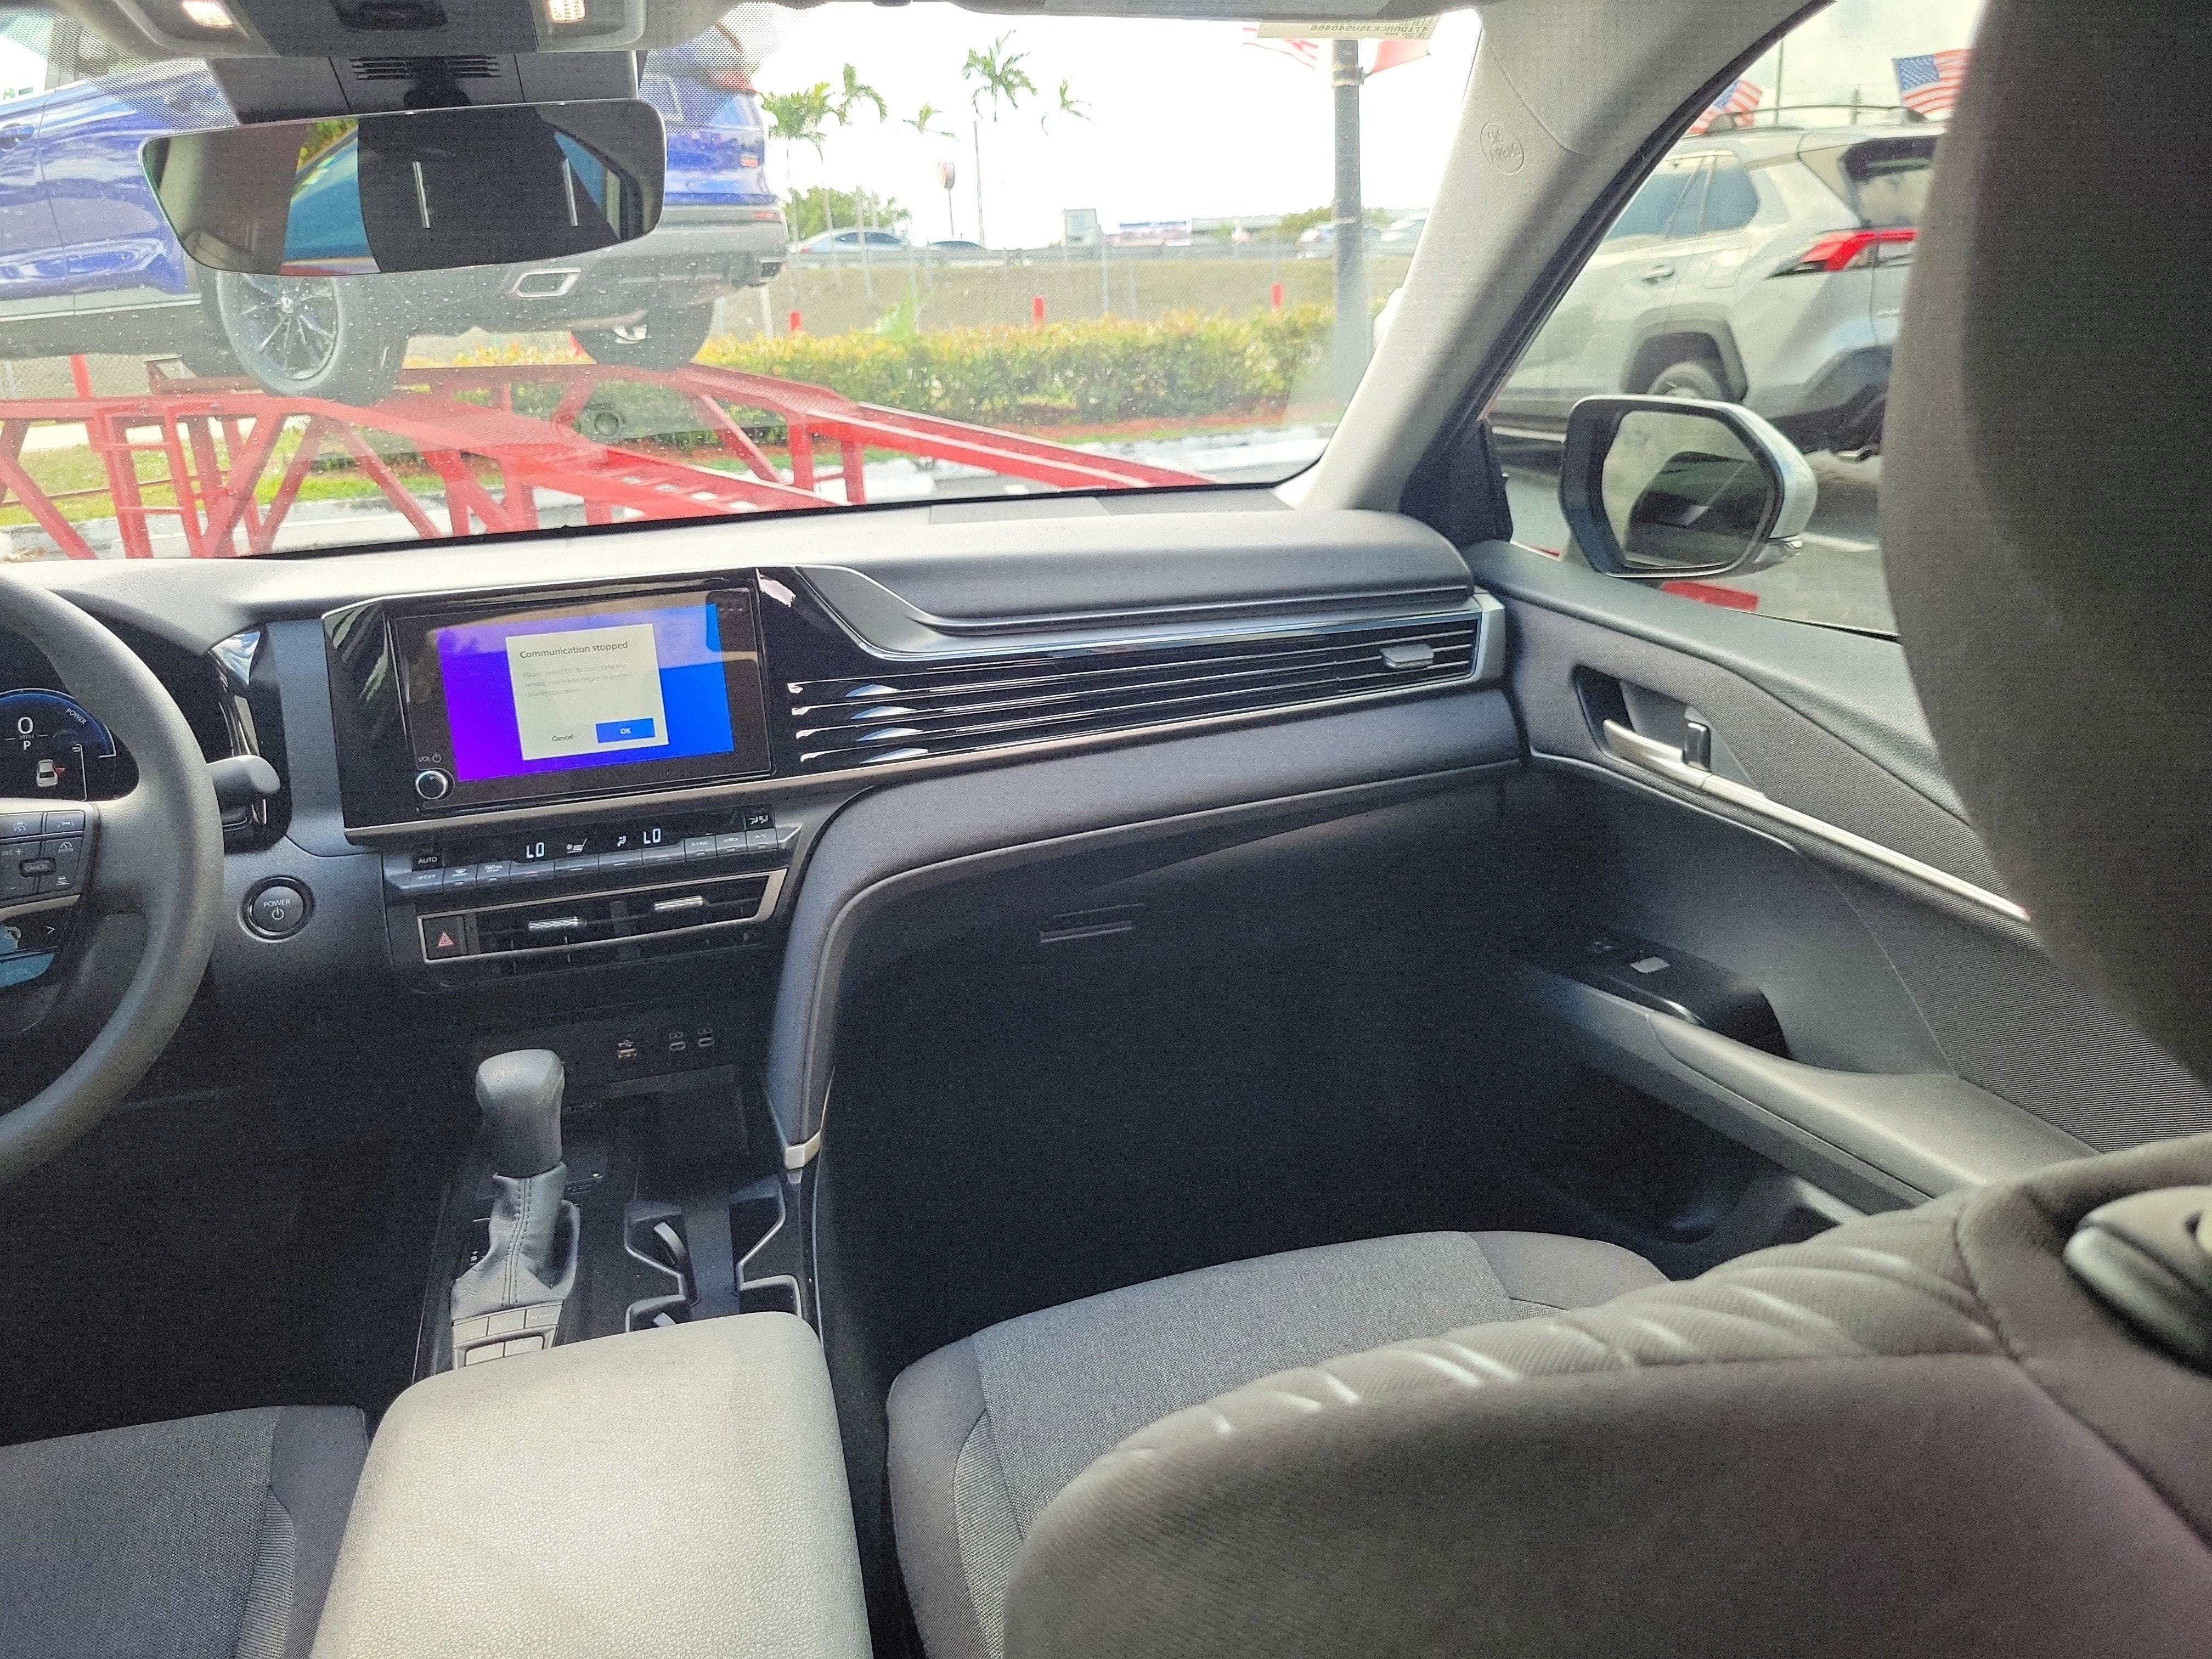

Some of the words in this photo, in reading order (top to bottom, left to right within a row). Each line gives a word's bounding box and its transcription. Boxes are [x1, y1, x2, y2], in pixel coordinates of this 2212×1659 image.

[520, 645, 590, 658] Communication
[592, 641, 629, 652] stopped
[584, 664, 615, 673] complete
[610, 671, 633, 680] normal
[66, 708, 87, 725] POWER
[18, 716, 33, 735] 0
[23, 740, 31, 751] P
[643, 828, 661, 844] LO
[526, 842, 545, 859] LO
[417, 856, 438, 865] AUTO
[25, 863, 48, 871] CANCEL
[263, 899, 291, 907] POWER
